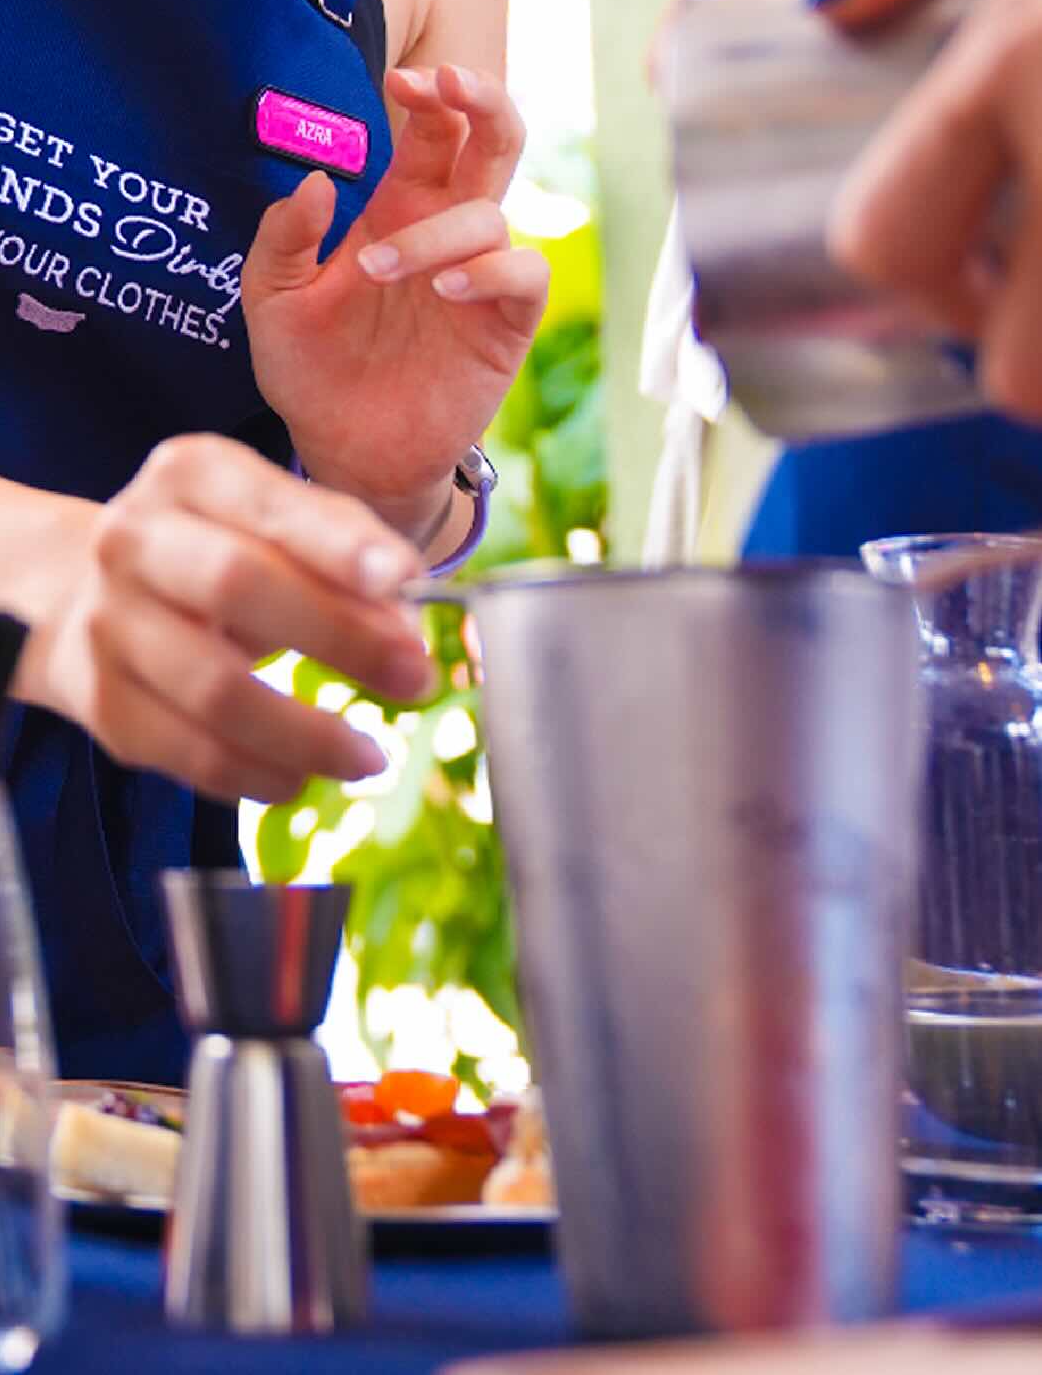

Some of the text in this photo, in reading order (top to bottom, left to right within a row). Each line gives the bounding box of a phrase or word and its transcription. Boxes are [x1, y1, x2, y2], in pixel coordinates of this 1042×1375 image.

[296, 118, 334, 147] AZRA
[90, 154, 210, 231] YOUR
[75, 267, 231, 350] CLOTHES.
